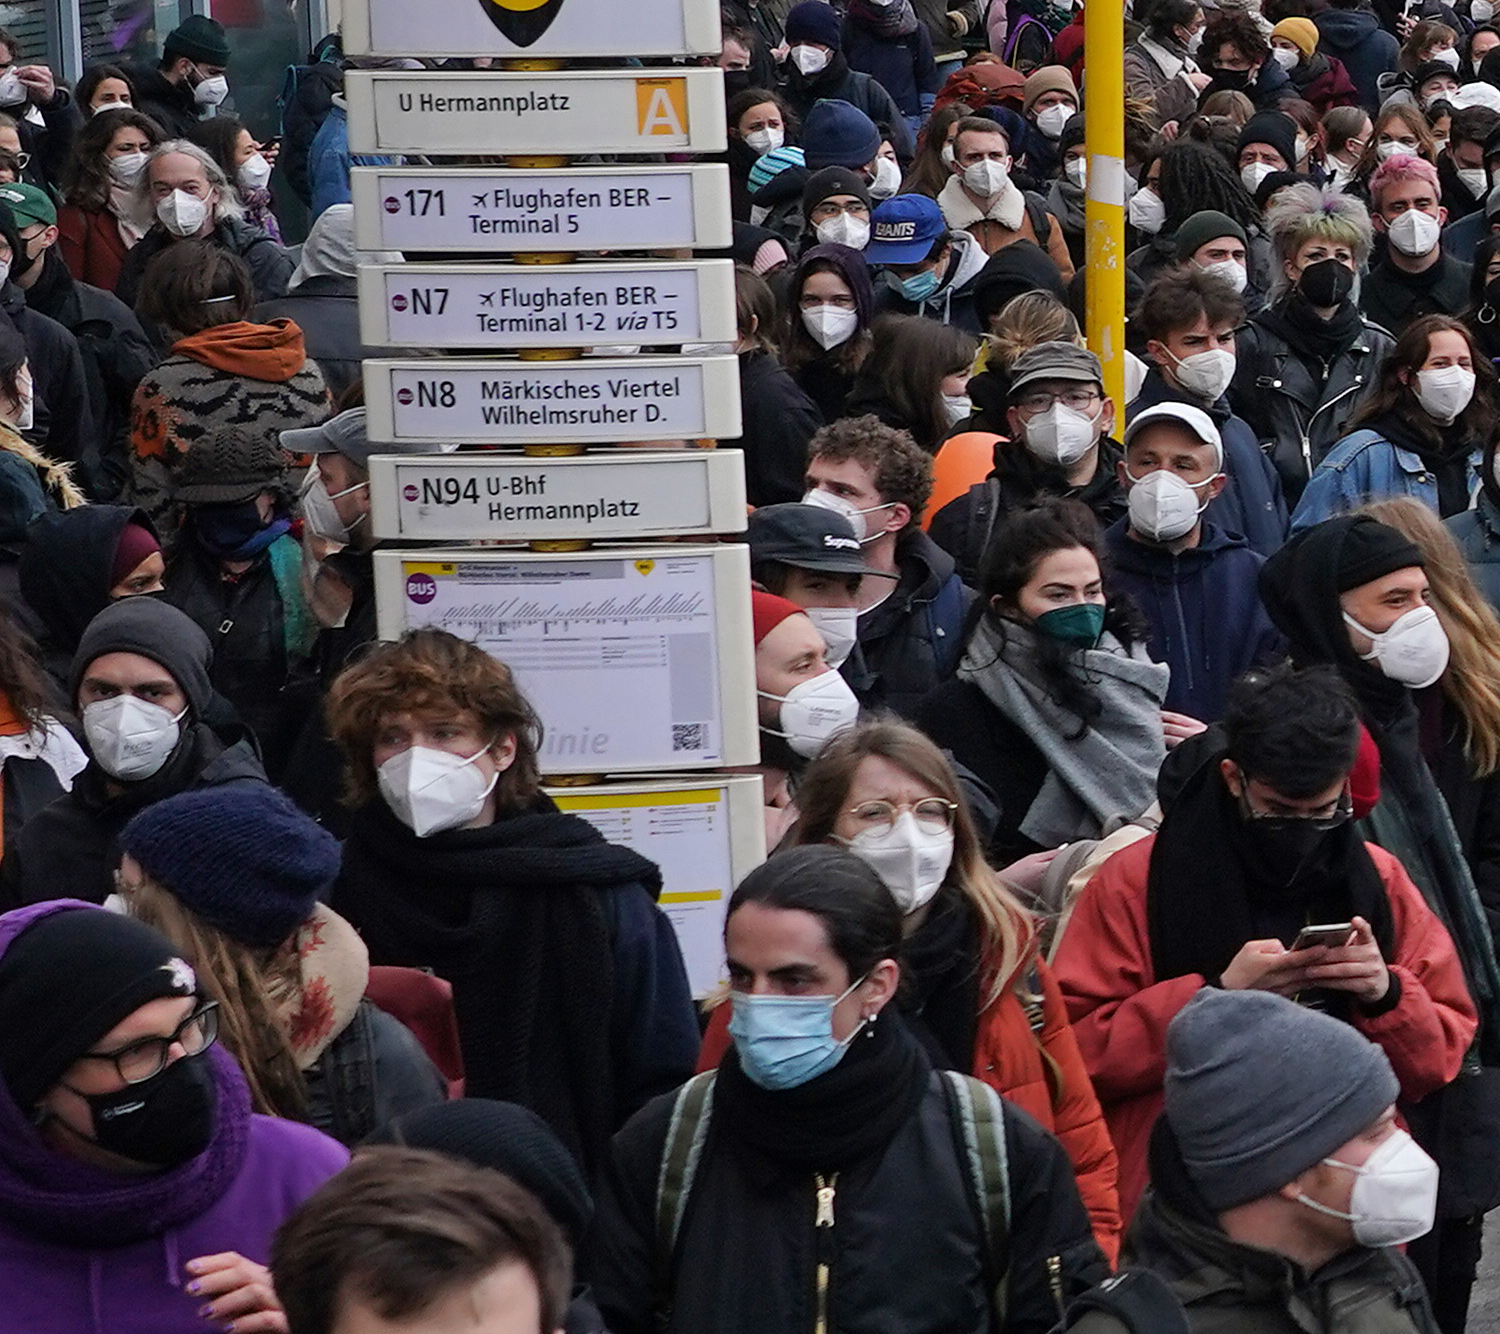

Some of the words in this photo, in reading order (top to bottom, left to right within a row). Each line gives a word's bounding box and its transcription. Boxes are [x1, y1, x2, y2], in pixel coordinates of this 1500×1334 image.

[400, 94, 413, 112] U
[419, 91, 571, 116] Hermannplatz
[641, 87, 691, 136] A
[404, 189, 446, 217] 171
[494, 189, 601, 214] Flughafen
[609, 189, 650, 208] BER
[469, 214, 560, 235] Terminal
[568, 214, 579, 234] 5
[874, 221, 917, 239] GIANTS
[412, 288, 449, 316] N7
[500, 287, 608, 313] Flughafen
[616, 287, 657, 306] BER
[477, 313, 567, 333] Terminal
[575, 313, 606, 332] 1-2
[617, 312, 649, 331] via
[653, 311, 678, 330] T5
[417, 380, 457, 409] N8
[481, 379, 601, 401] Märkisches
[608, 377, 680, 399] Viertel
[482, 405, 638, 426] Wilhelmsruher
[644, 404, 667, 423] D.
[423, 476, 480, 506] N94
[486, 474, 547, 496] U-Bhf
[488, 500, 640, 525] Hermannplatz
[407, 581, 436, 597] BUS
[547, 726, 609, 755] inie
